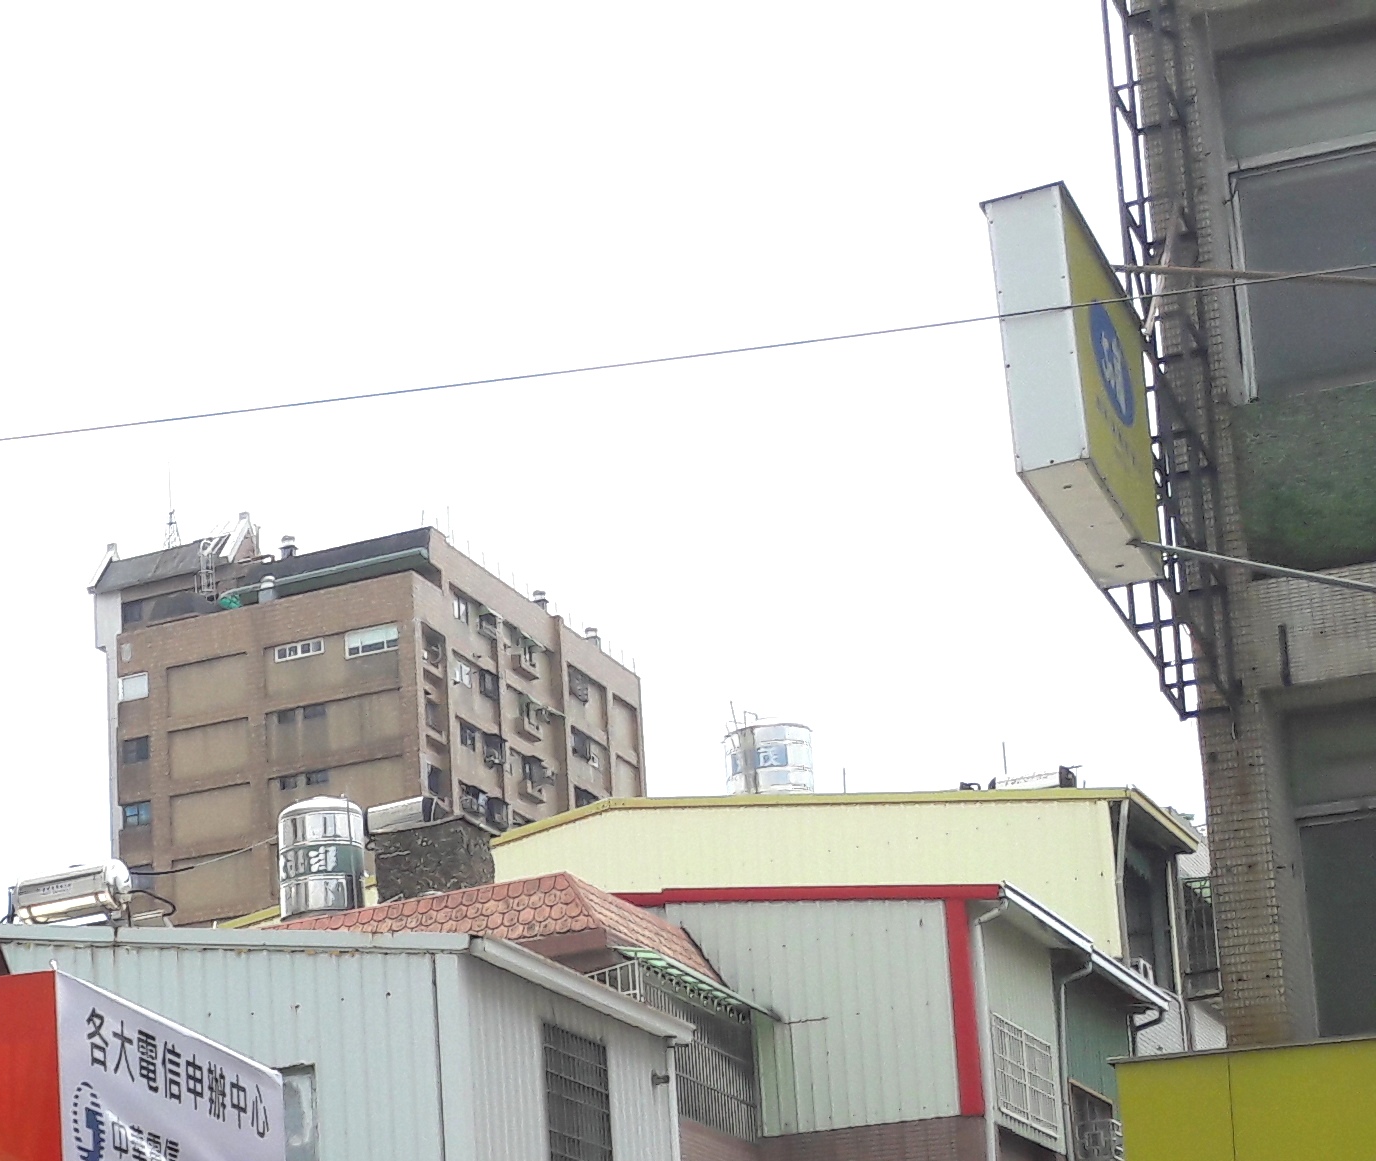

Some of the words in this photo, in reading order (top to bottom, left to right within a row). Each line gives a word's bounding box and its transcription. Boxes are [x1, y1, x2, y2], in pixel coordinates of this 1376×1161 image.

[85, 1006, 271, 1139] 各大電信申辦中心
